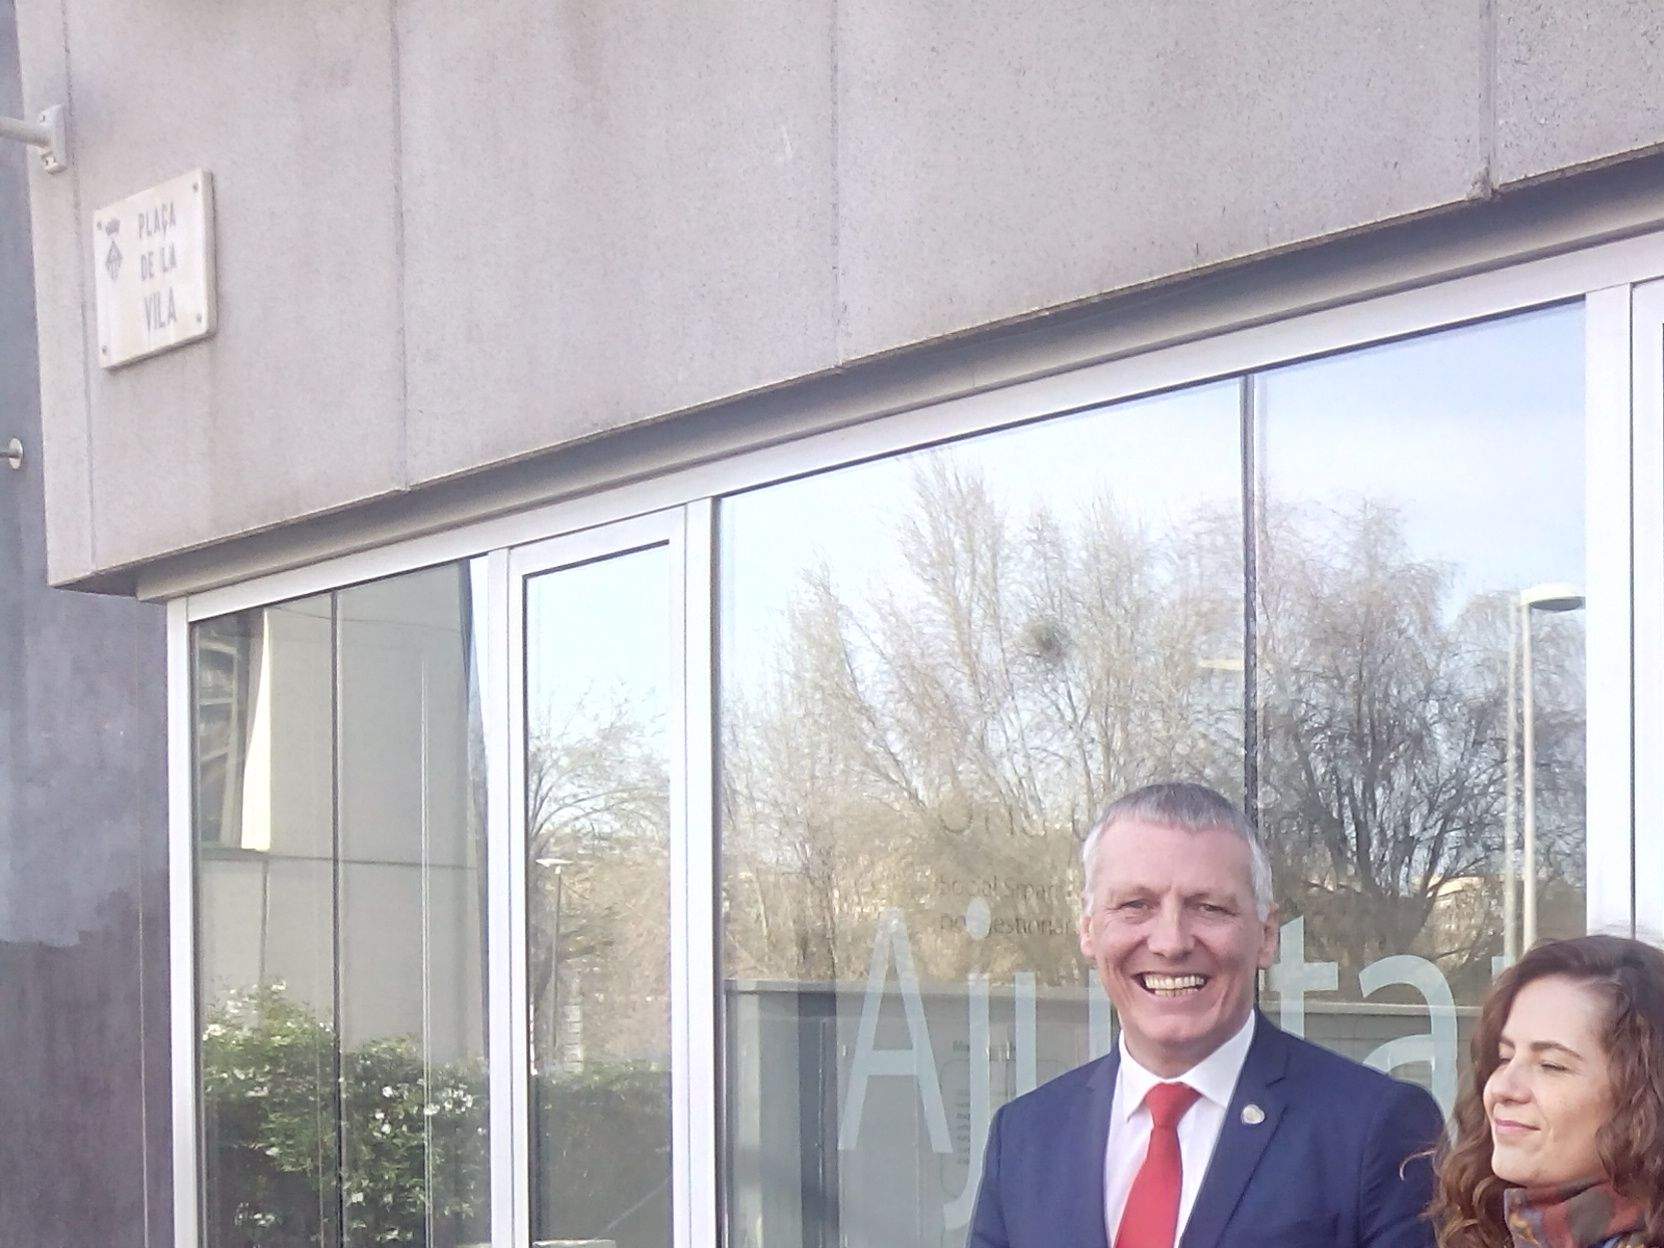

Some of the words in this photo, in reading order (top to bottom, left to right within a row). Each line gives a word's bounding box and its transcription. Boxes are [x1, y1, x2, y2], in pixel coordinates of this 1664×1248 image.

[138, 201, 176, 240] PLAÇA
[140, 251, 154, 281] DE
[161, 240, 177, 273] LA
[144, 286, 177, 334] VILA
